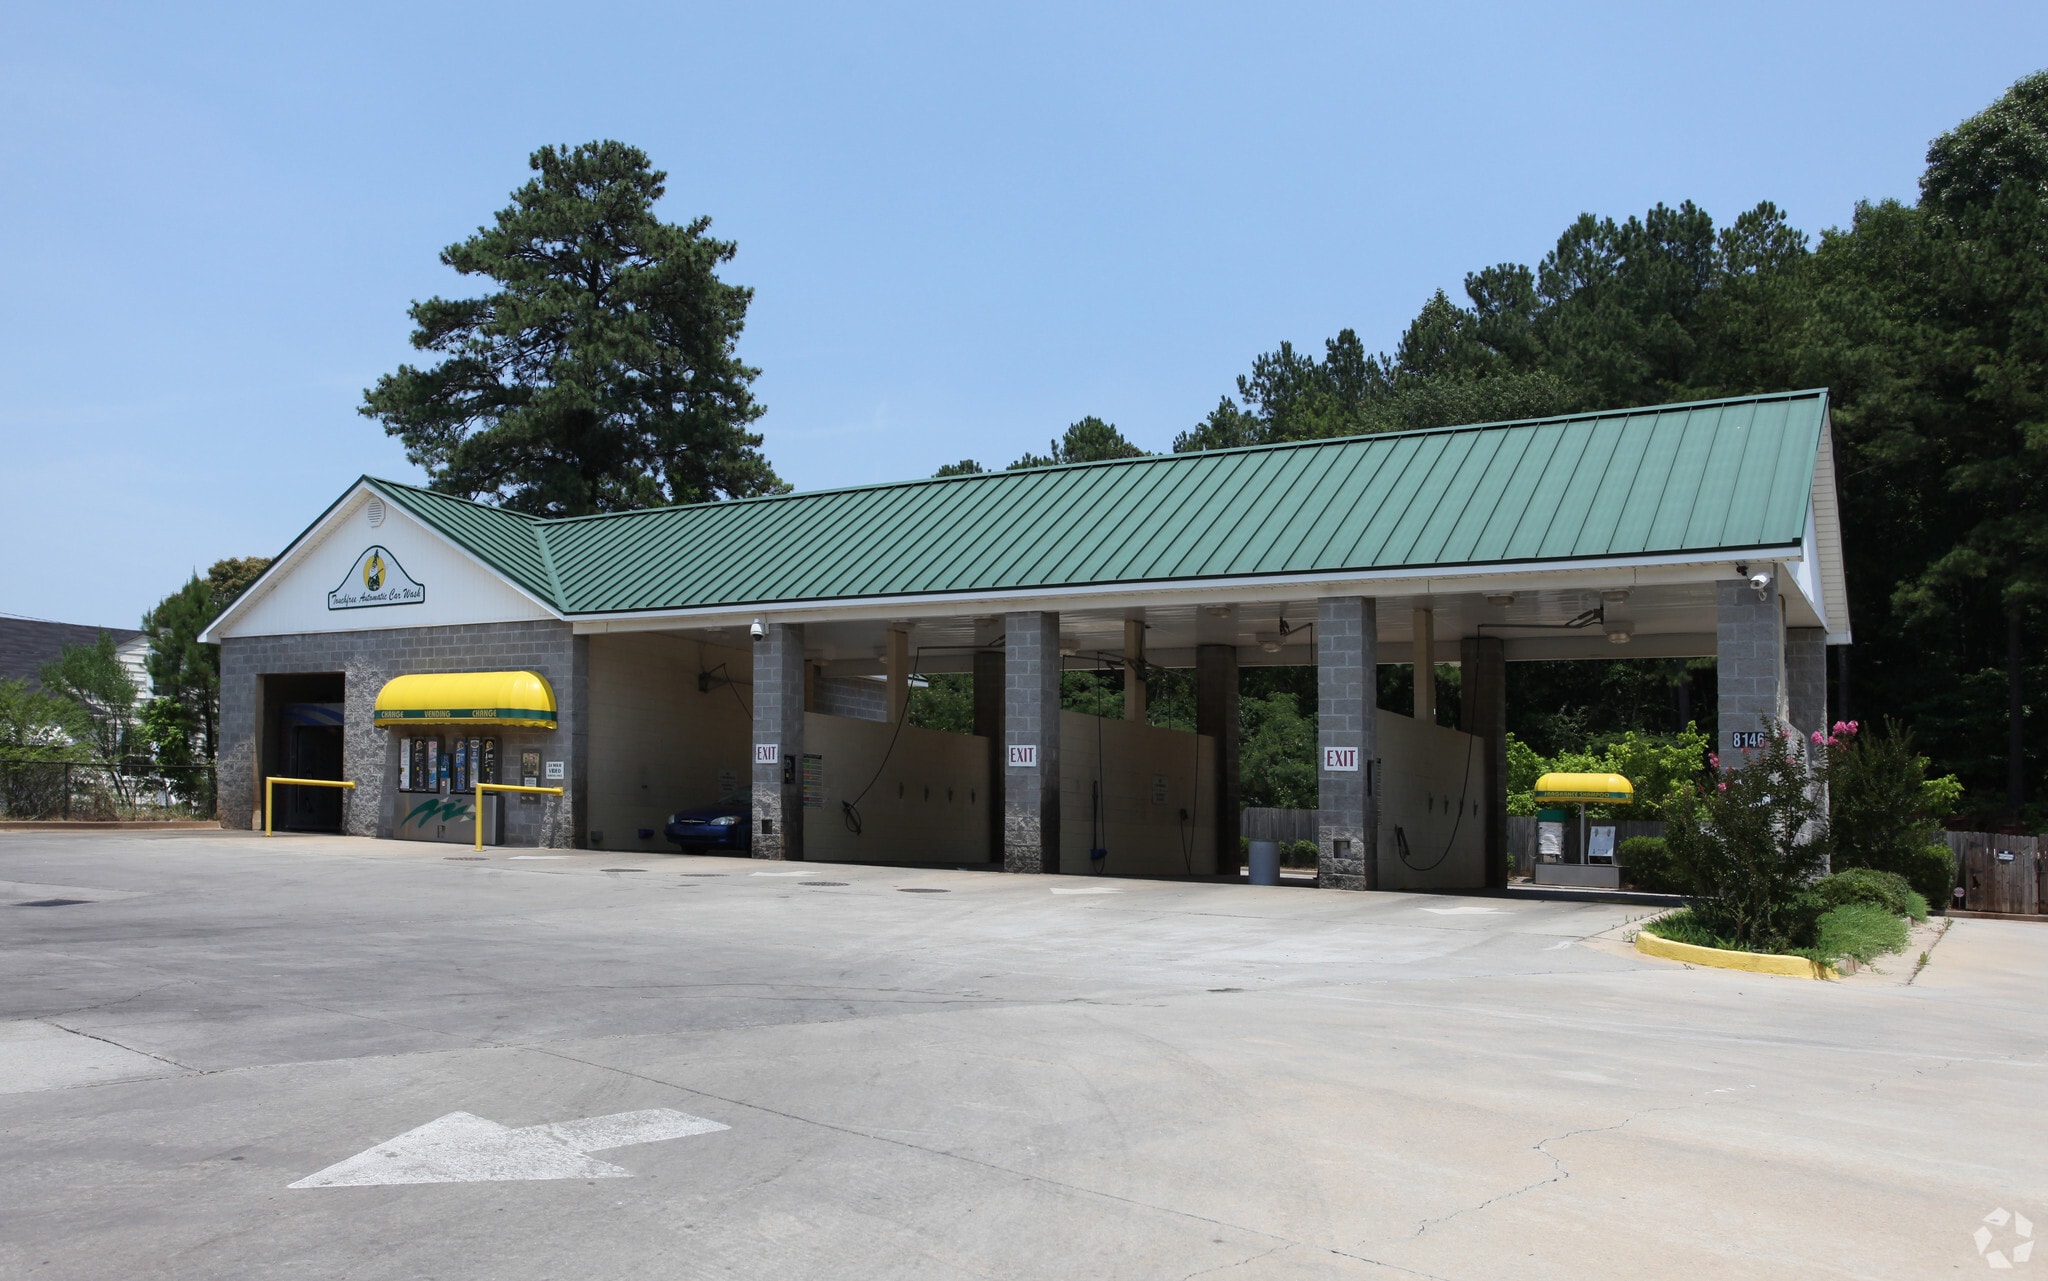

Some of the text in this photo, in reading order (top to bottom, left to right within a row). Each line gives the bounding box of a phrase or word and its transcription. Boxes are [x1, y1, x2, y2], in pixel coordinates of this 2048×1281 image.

[332, 587, 421, 607] Touchfree Automatic Car Wash
[381, 709, 497, 718] CHANGE VENDING CHANGE
[1733, 732, 1765, 748] 8146
[757, 746, 777, 760] EXIT
[1010, 747, 1035, 763] EXIT
[1326, 749, 1356, 767] EXIT
